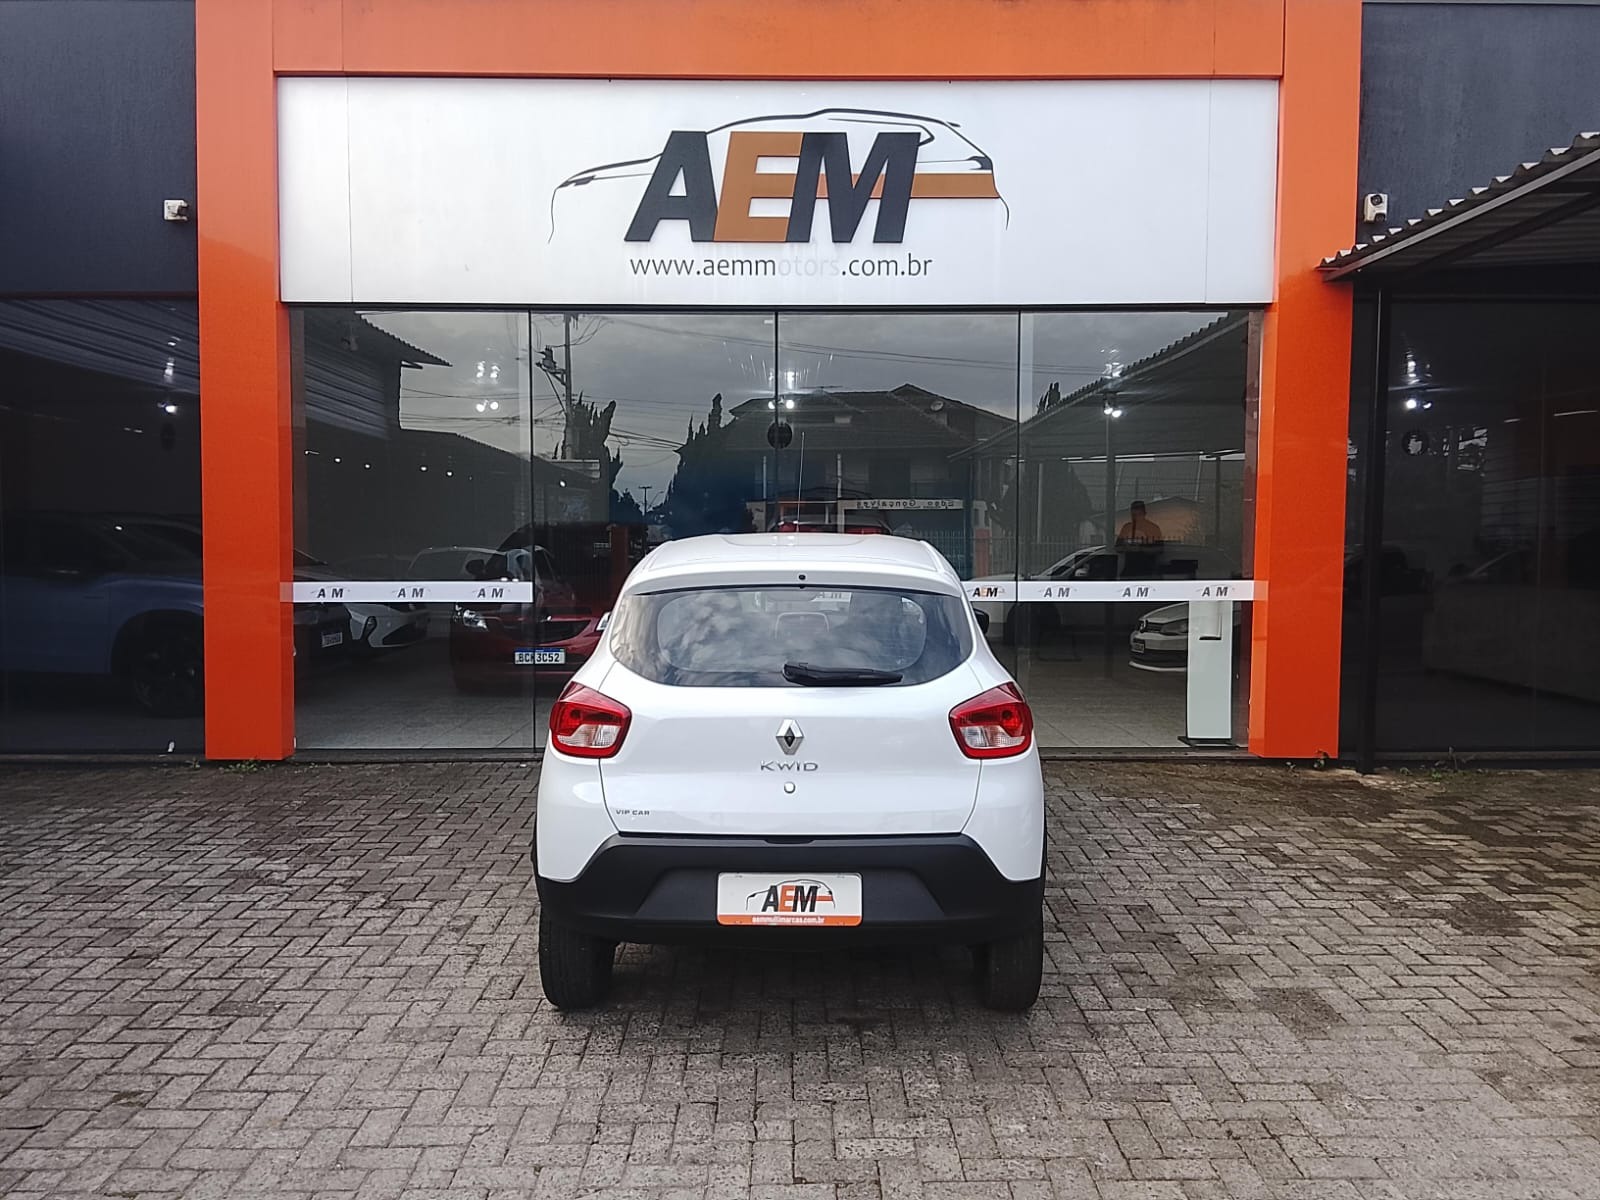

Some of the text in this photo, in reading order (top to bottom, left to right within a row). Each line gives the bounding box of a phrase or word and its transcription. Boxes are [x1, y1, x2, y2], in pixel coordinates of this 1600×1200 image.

[624, 131, 921, 243] AEM
[630, 253, 933, 276] www.aemmotors.com.br
[760, 761, 819, 772] KWID
[761, 885, 819, 913] AEM
